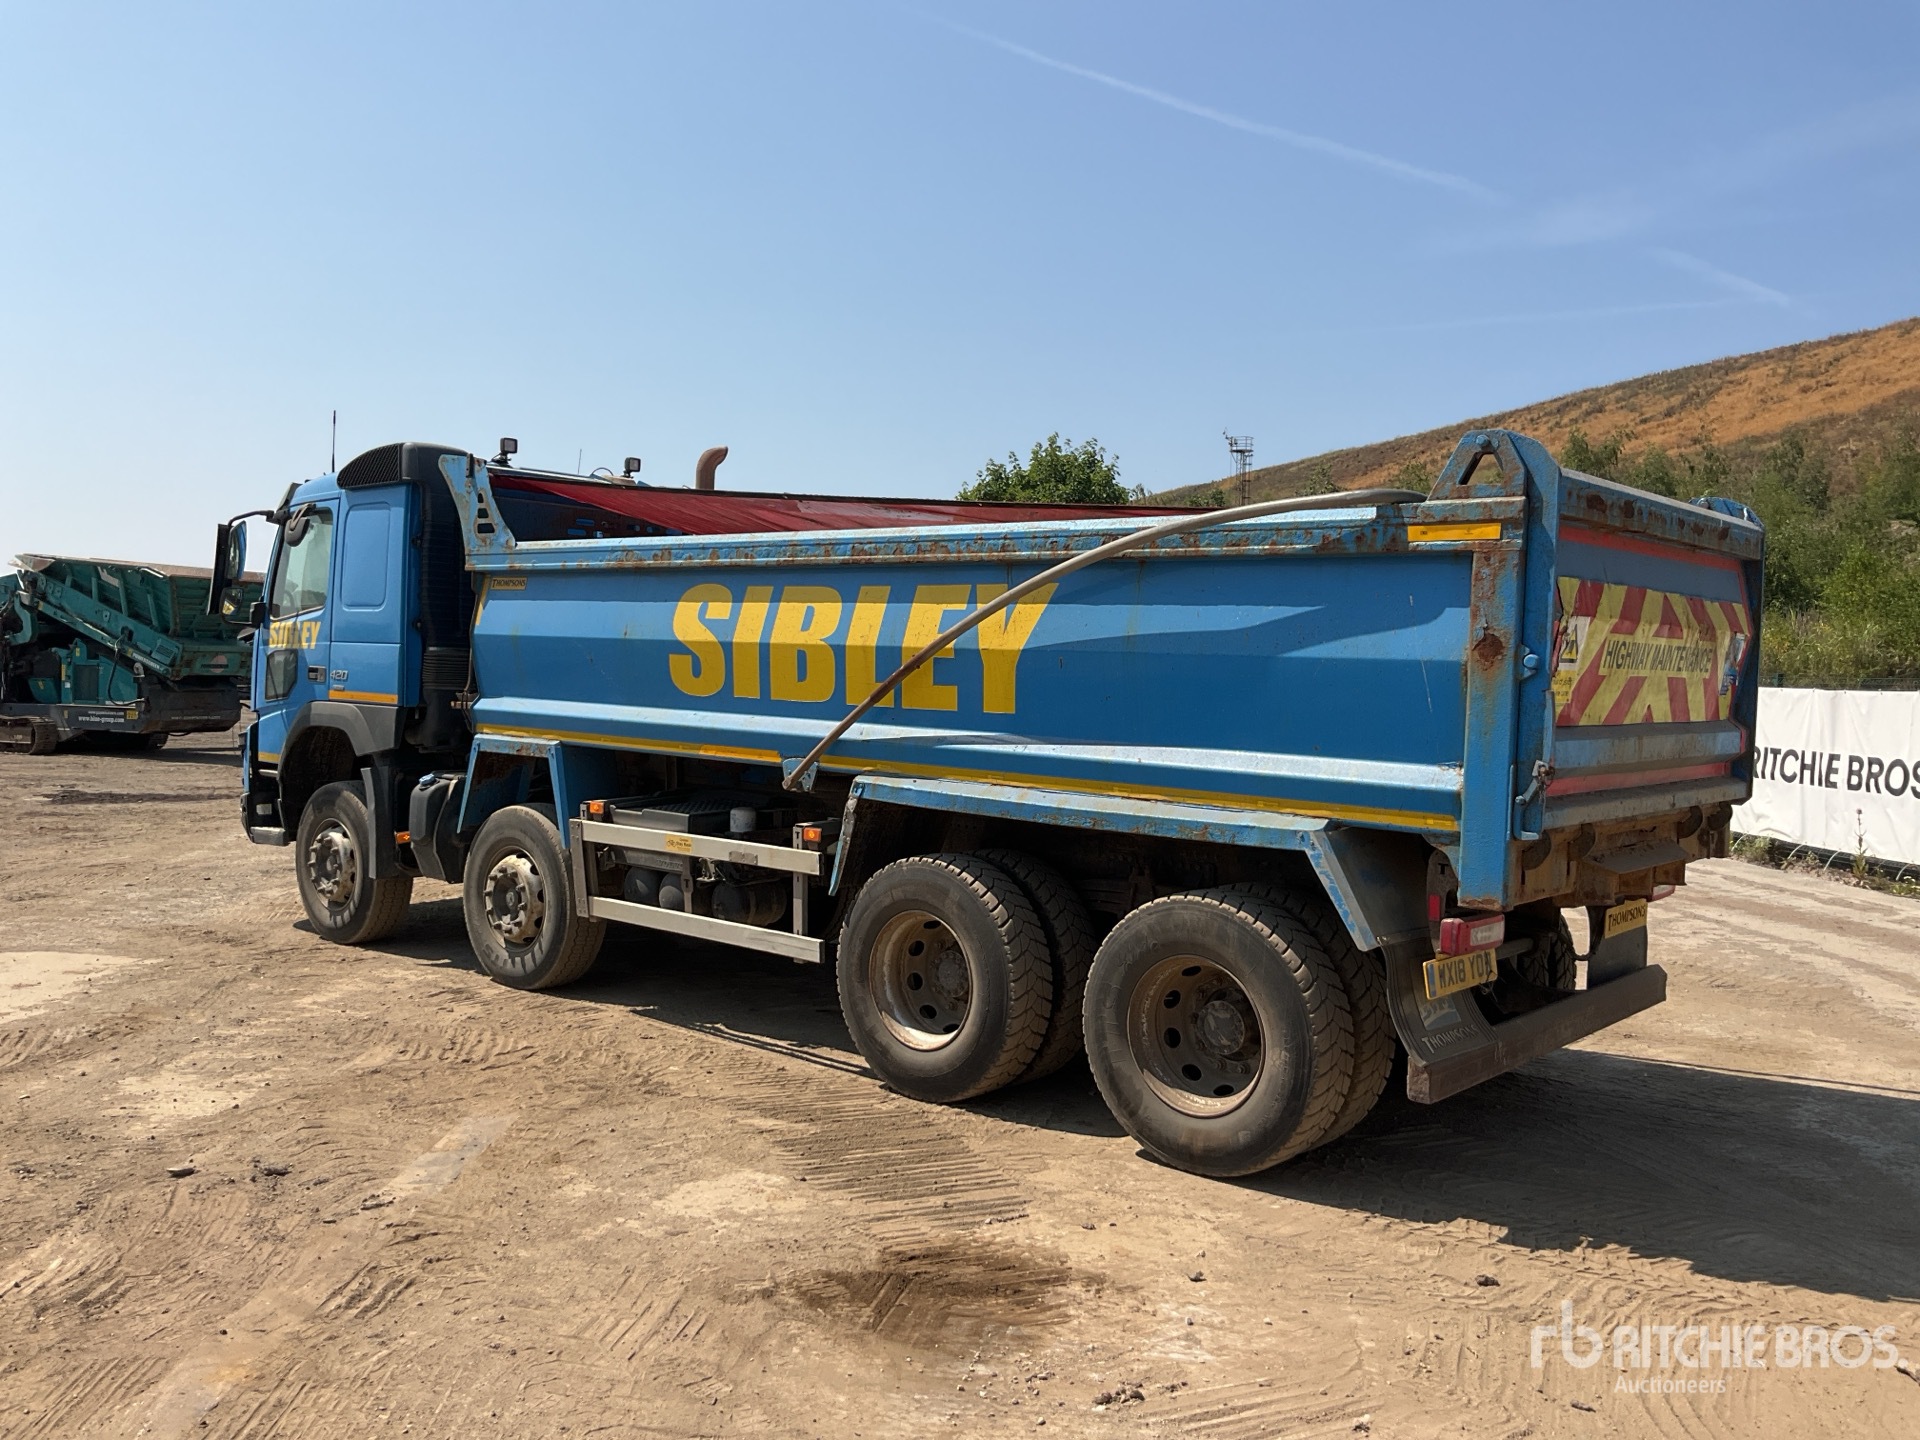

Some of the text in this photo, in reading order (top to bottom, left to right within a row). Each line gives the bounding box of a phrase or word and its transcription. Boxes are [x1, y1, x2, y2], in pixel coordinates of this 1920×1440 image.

[492, 578, 526, 588] THOMPSONS
[669, 583, 1059, 714] SIBLEY
[1603, 640, 1713, 673] HIGHWAY MAINTENANCE
[1608, 904, 1646, 931] THOMPSONS
[1422, 1024, 1480, 1053] THOMPSONS
